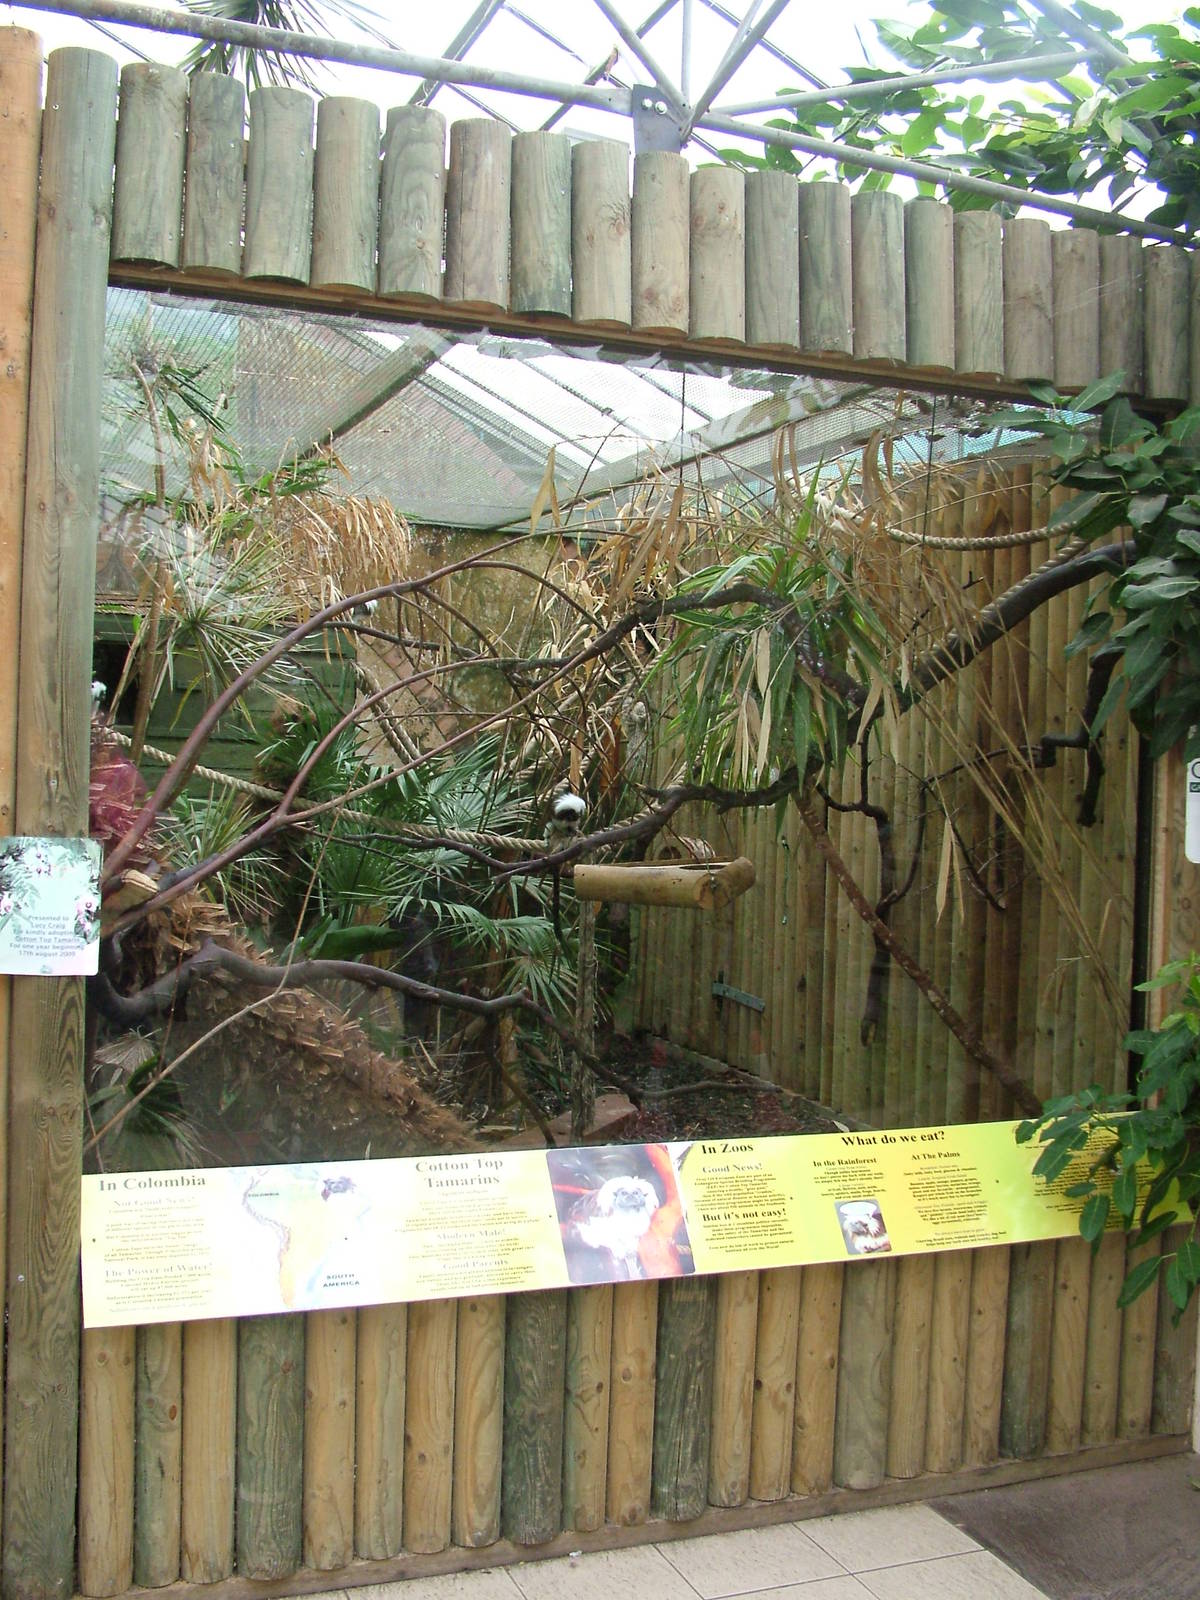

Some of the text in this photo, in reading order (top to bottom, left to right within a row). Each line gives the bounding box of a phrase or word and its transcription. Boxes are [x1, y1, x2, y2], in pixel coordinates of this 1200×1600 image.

[40, 936, 52, 944] Top
[841, 1130, 945, 1147] What do we eat?
[702, 1143, 754, 1154] In Zoos
[911, 1153, 920, 1161] At
[937, 1151, 960, 1159] Palms
[415, 1159, 504, 1173] Cotton Top
[702, 1162, 763, 1174] Good News!
[813, 1157, 877, 1168] In the Rainforest
[100, 1175, 206, 1191] In Colombia
[424, 1174, 501, 1188] Tamarins
[702, 1207, 787, 1222] But it's not easy!
[322, 1280, 360, 1288] AMERICA
